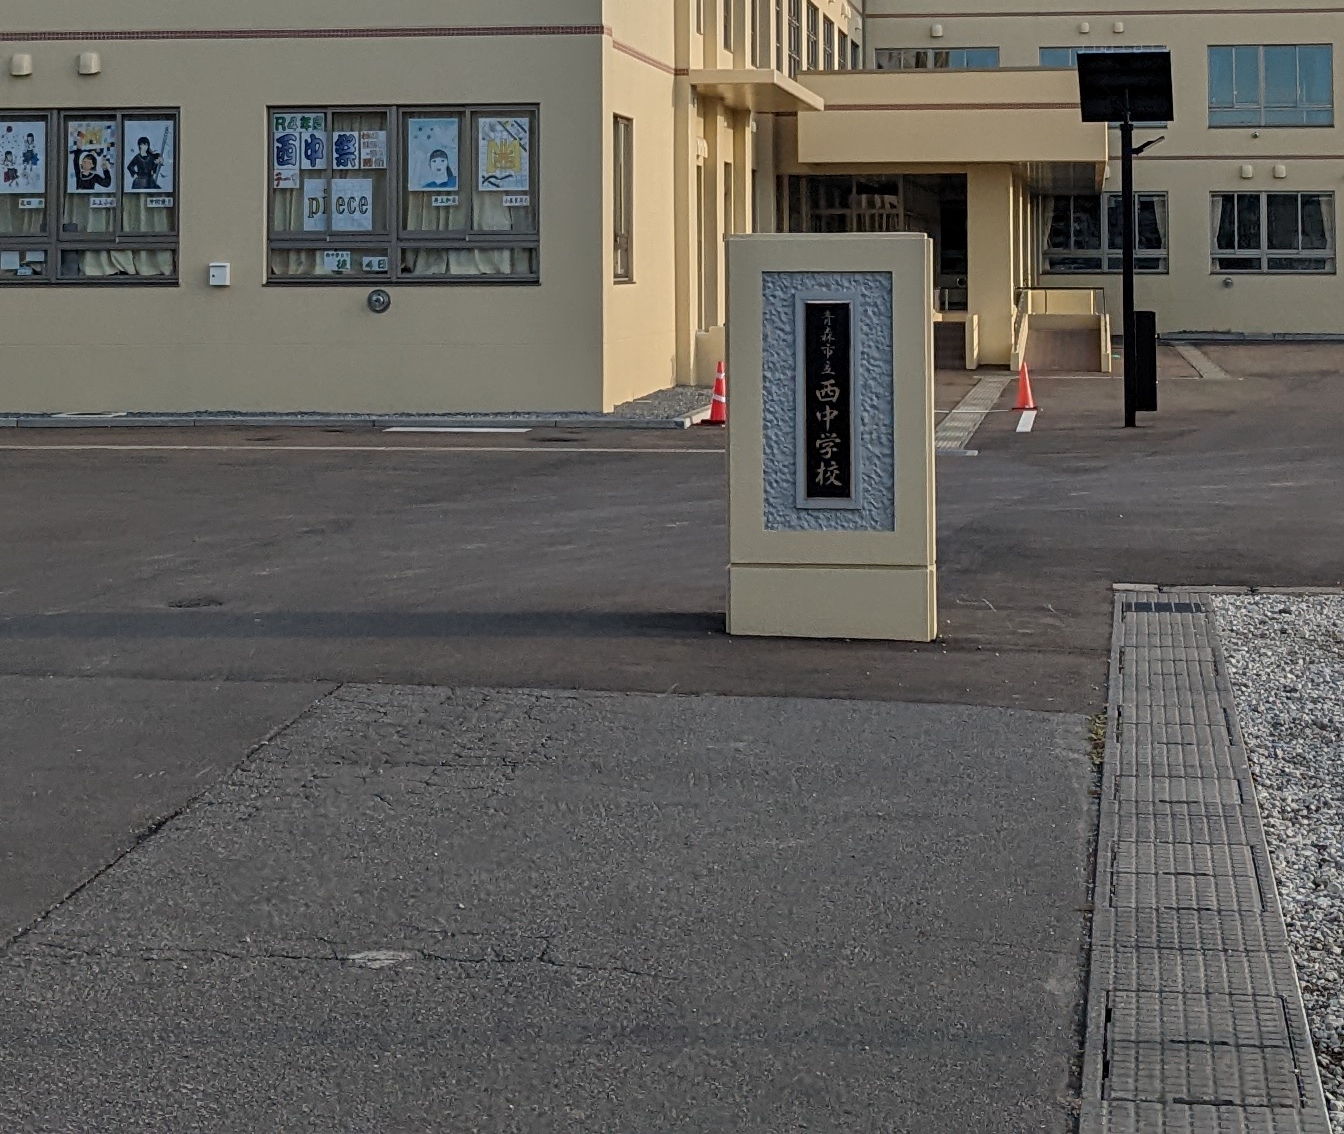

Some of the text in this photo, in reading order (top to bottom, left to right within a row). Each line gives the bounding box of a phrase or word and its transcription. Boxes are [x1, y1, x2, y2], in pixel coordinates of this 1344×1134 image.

[815, 309, 843, 487] 青森市立西中学校
